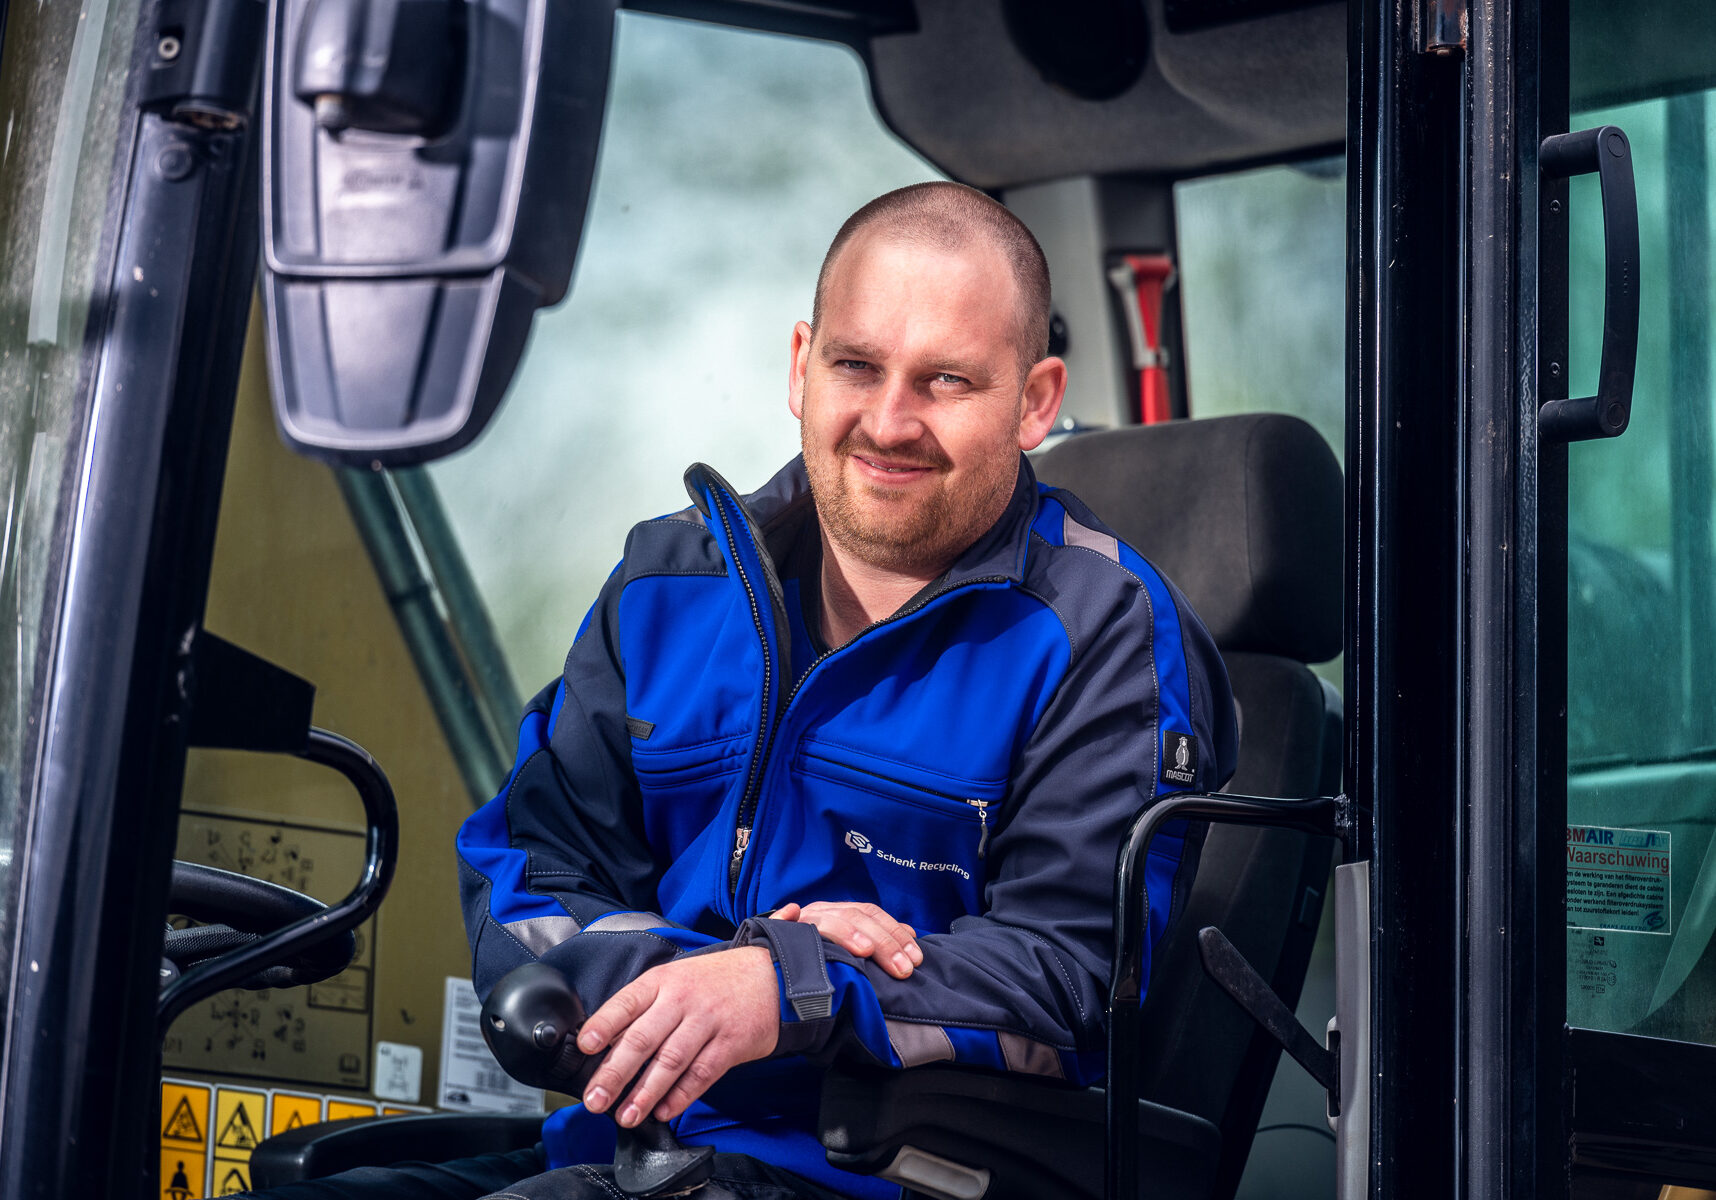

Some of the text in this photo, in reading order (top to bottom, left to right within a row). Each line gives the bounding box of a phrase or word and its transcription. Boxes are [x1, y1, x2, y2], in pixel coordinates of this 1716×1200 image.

[1166, 769, 1194, 783] MASCOT
[876, 849, 970, 880] Schenk Recycling
[1583, 871, 1603, 880] werking
[1567, 880, 1586, 888] ysteem
